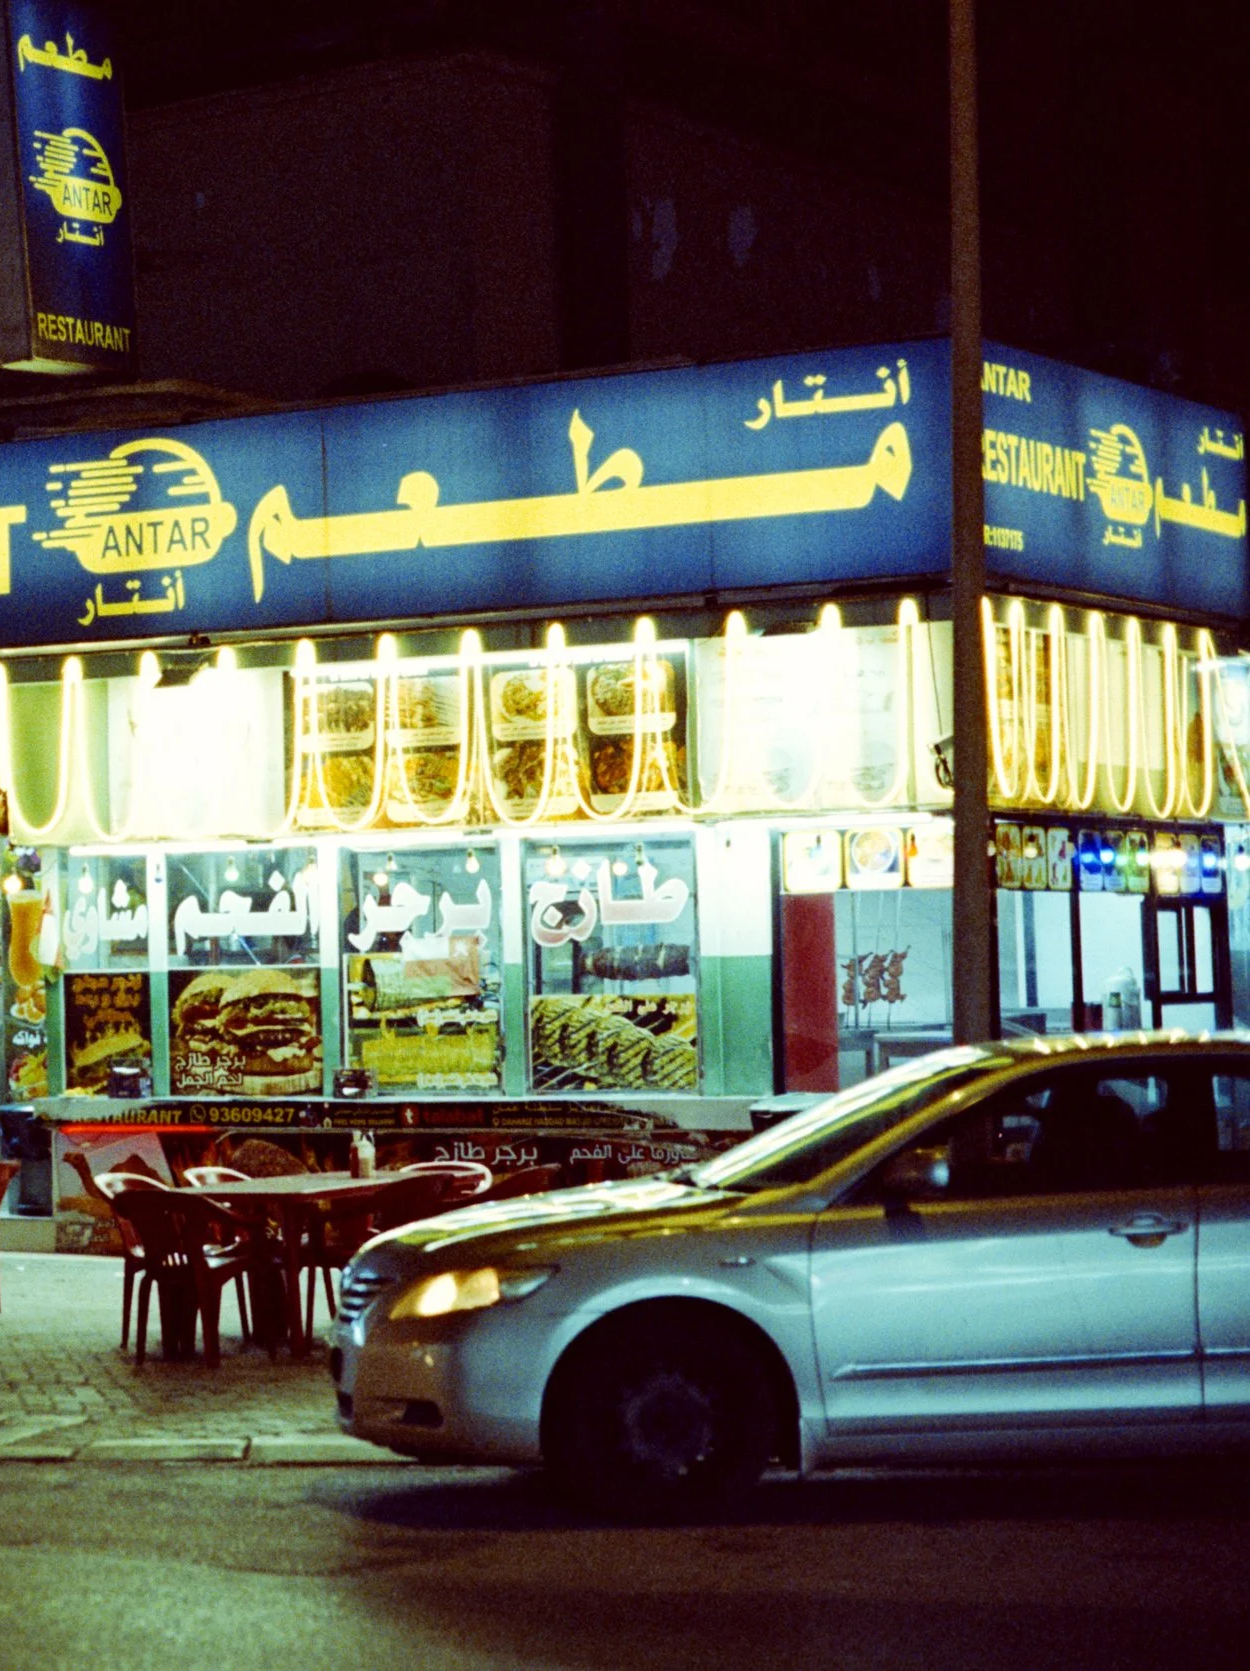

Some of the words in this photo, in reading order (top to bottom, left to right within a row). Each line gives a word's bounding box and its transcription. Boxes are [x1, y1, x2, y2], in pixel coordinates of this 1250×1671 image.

[17, 31, 113, 80] مطعم
[62, 183, 113, 216] ANTAR
[37, 311, 131, 352] RESTAURANT
[981, 361, 1031, 402] NTAR
[981, 428, 1086, 502] ESTAURANT
[249, 408, 912, 604] مطعم
[100, 517, 212, 560] ANTAR
[63, 878, 148, 960] مشاوي
[173, 868, 320, 957] الفحم
[528, 858, 689, 948] طازج
[209, 1107, 296, 1123] 93609427
[434, 1142, 486, 1164] طازج
[491, 1144, 538, 1167] برجر
[569, 1144, 612, 1164] الفحم
[617, 1144, 645, 1165] على
